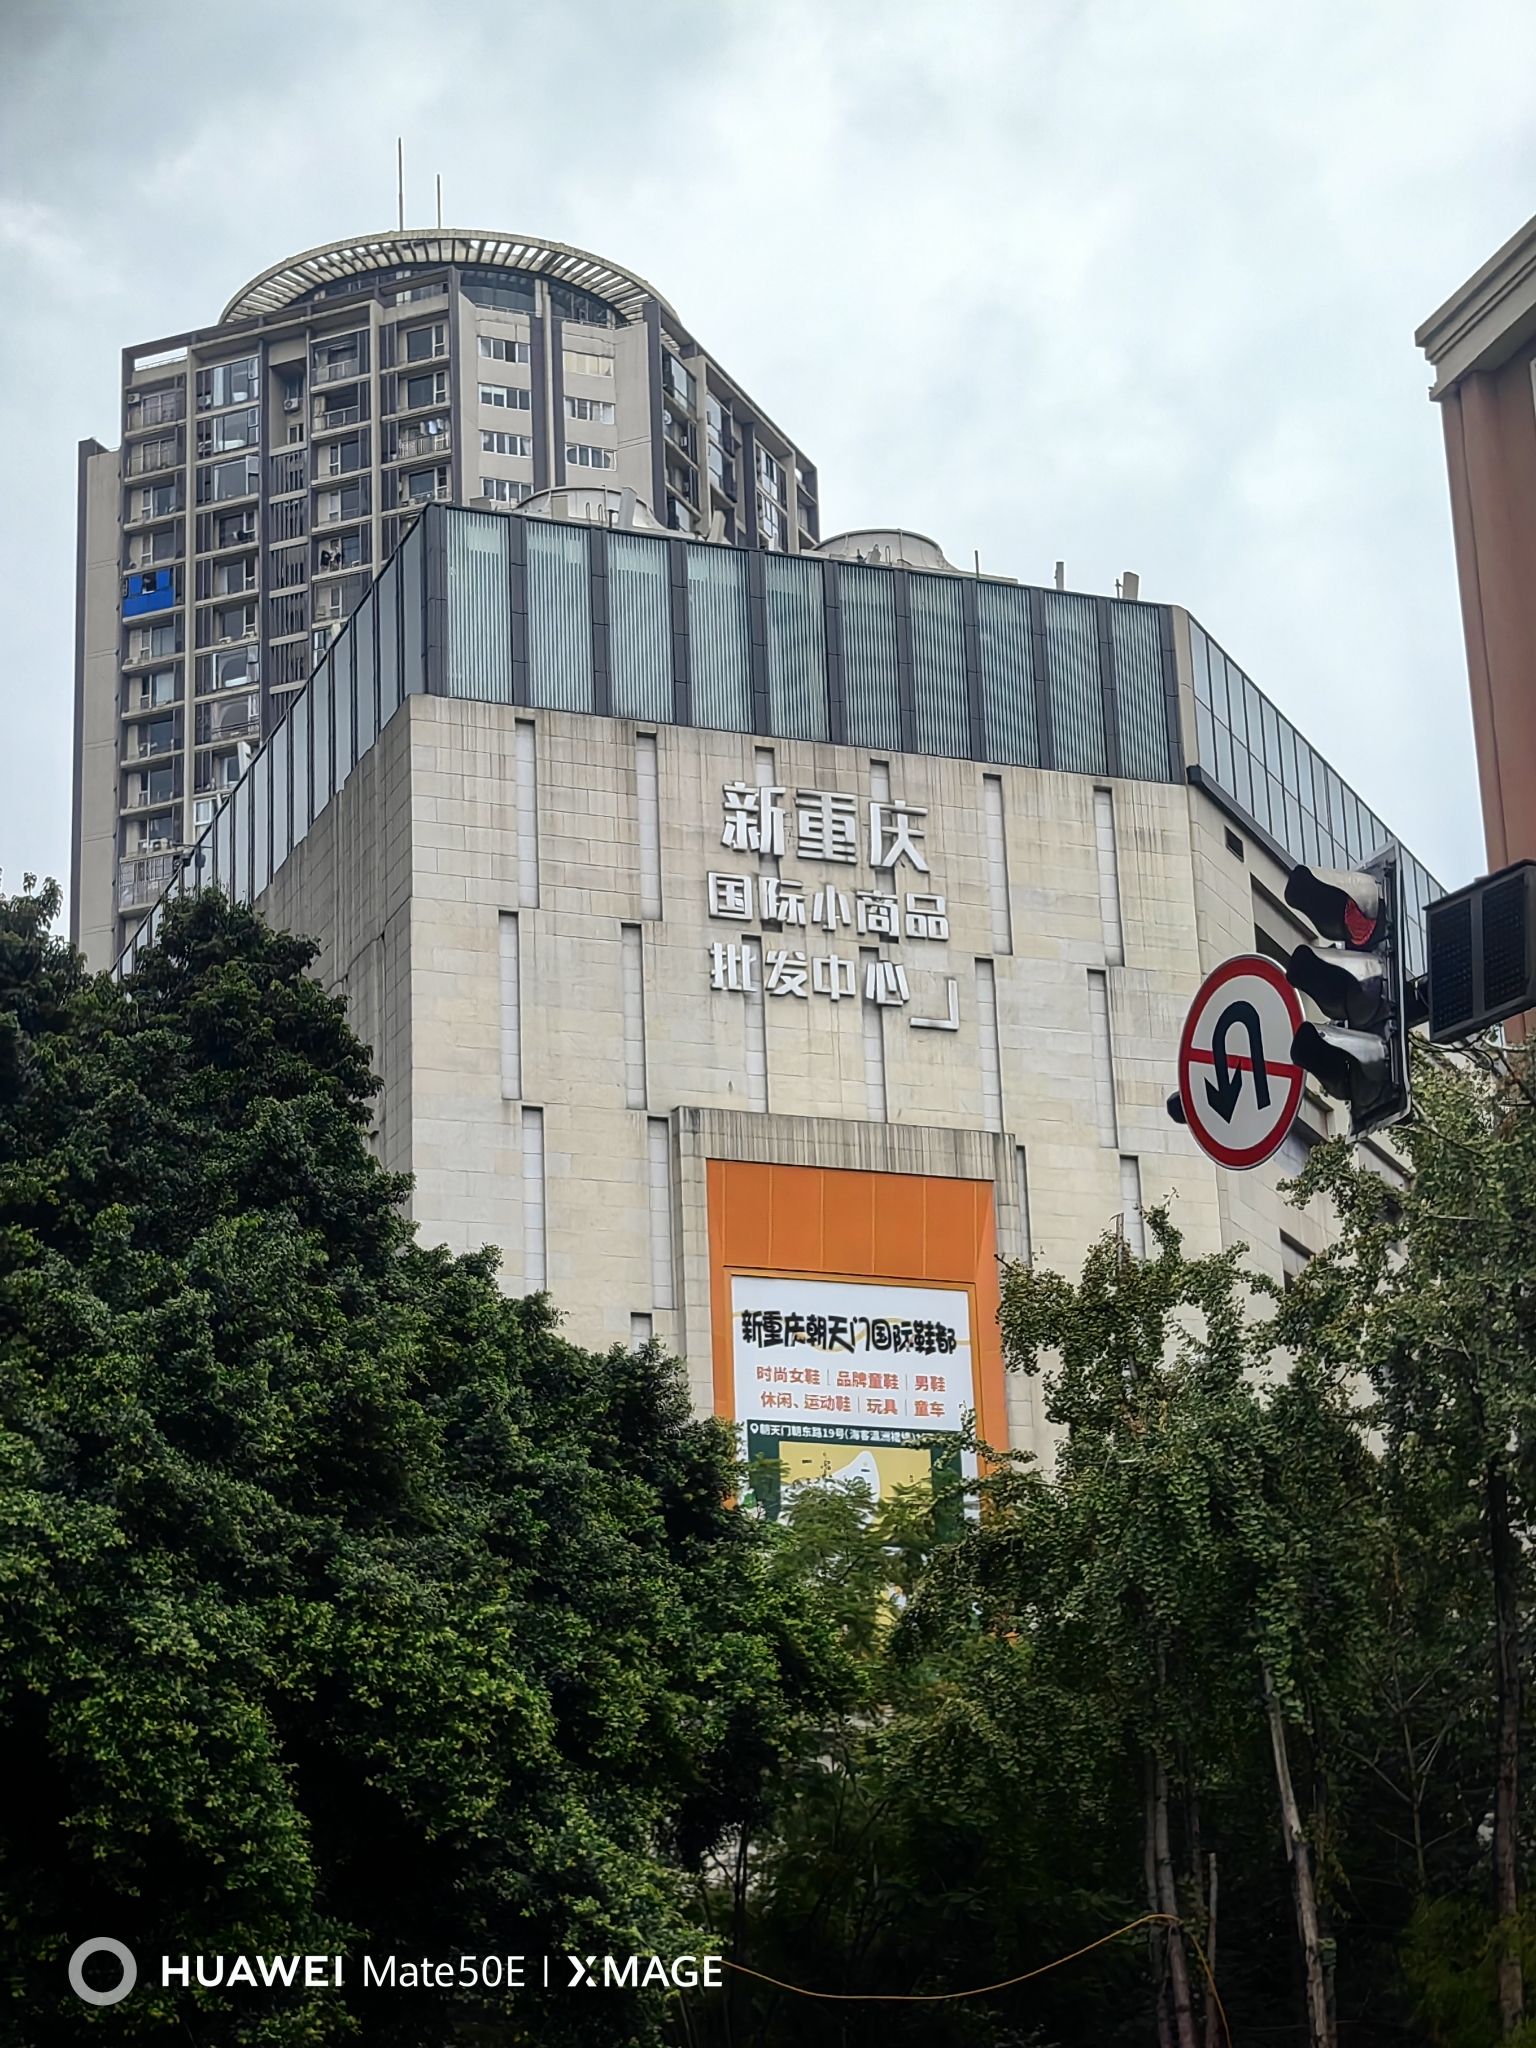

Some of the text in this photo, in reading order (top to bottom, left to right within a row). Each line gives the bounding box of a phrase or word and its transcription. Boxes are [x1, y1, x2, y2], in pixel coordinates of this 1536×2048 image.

[720, 781, 930, 873] 新重庆
[707, 871, 949, 941] 国际小商品
[709, 942, 910, 1006] 批发中心
[741, 1309, 957, 1355] 新重庆朝天门国际鞋都
[756, 1366, 946, 1392] 时尚女鞋 品牌童鞋 男鞋
[866, 1398, 898, 1415] 玩具
[914, 1400, 945, 1417] 童车
